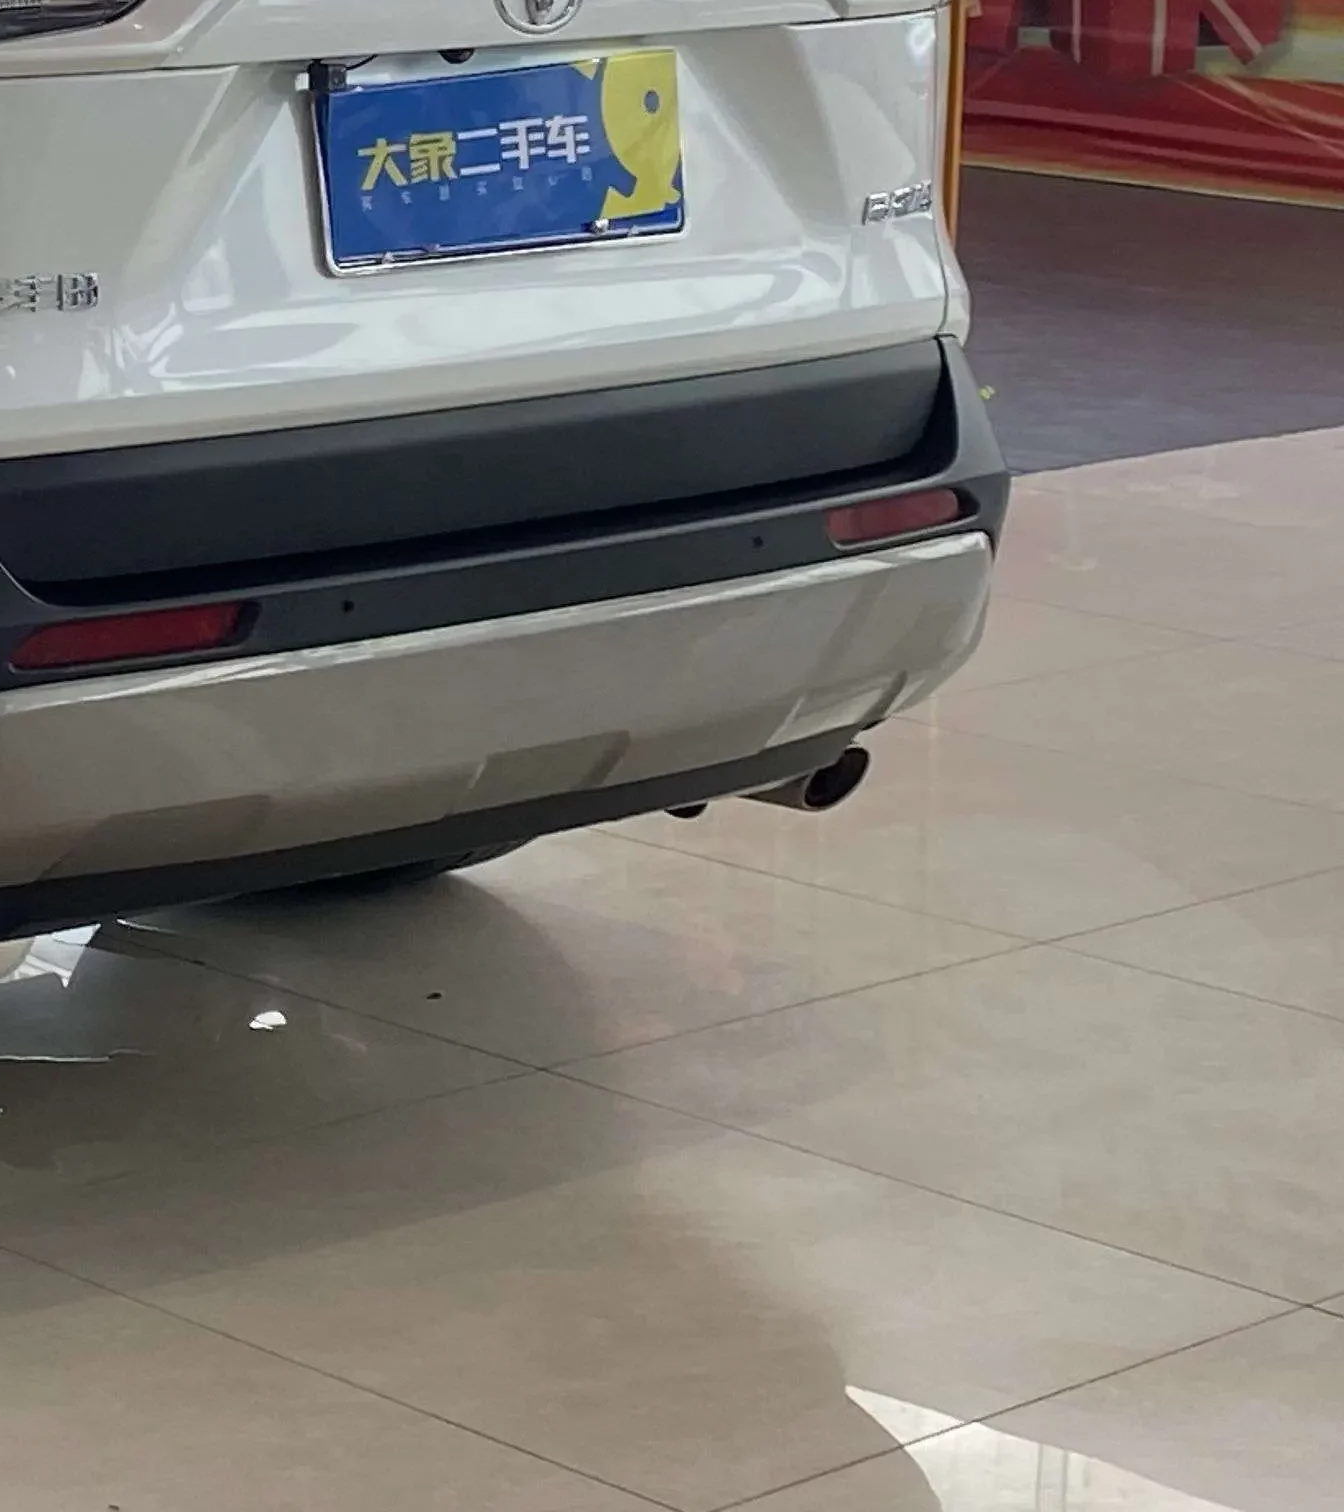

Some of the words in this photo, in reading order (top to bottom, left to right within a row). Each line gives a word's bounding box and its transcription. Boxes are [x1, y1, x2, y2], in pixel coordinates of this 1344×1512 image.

[357, 115, 591, 191] 大象二手车
